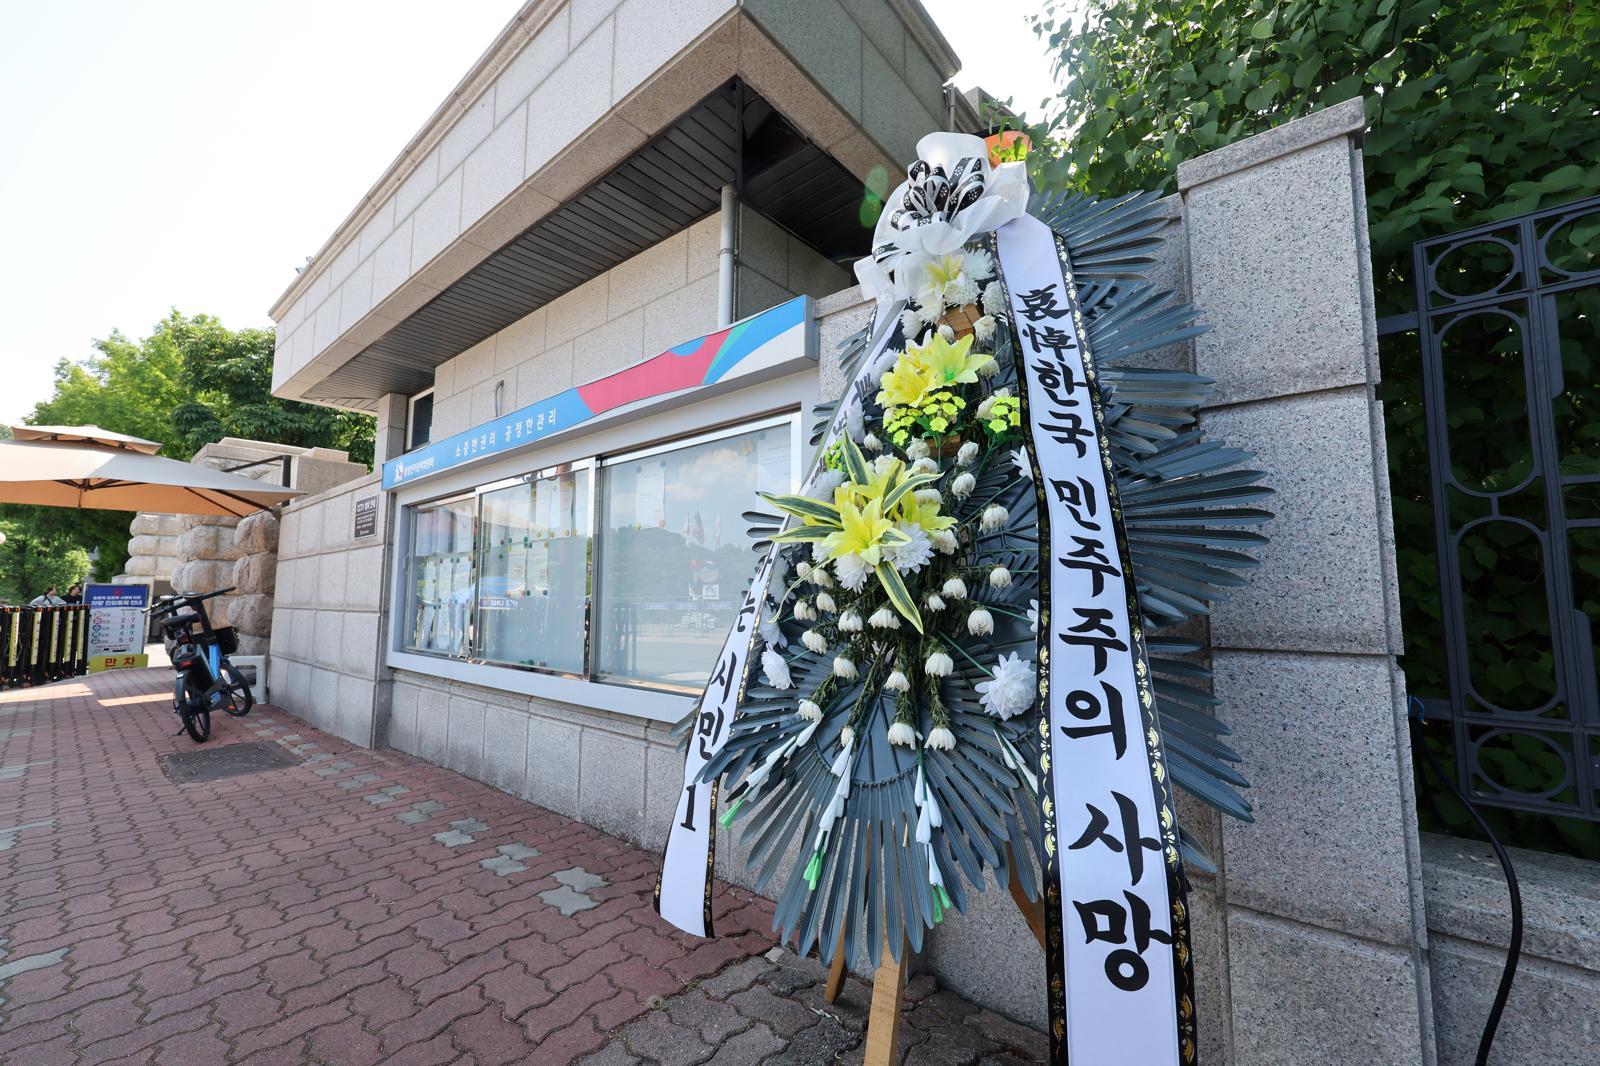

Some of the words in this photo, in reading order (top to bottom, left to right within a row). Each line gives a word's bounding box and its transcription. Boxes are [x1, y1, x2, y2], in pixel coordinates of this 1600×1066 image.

[697, 652, 737, 760] 시민
[1048, 476, 1128, 760] 민주주의
[1068, 790, 1172, 992] 사망
